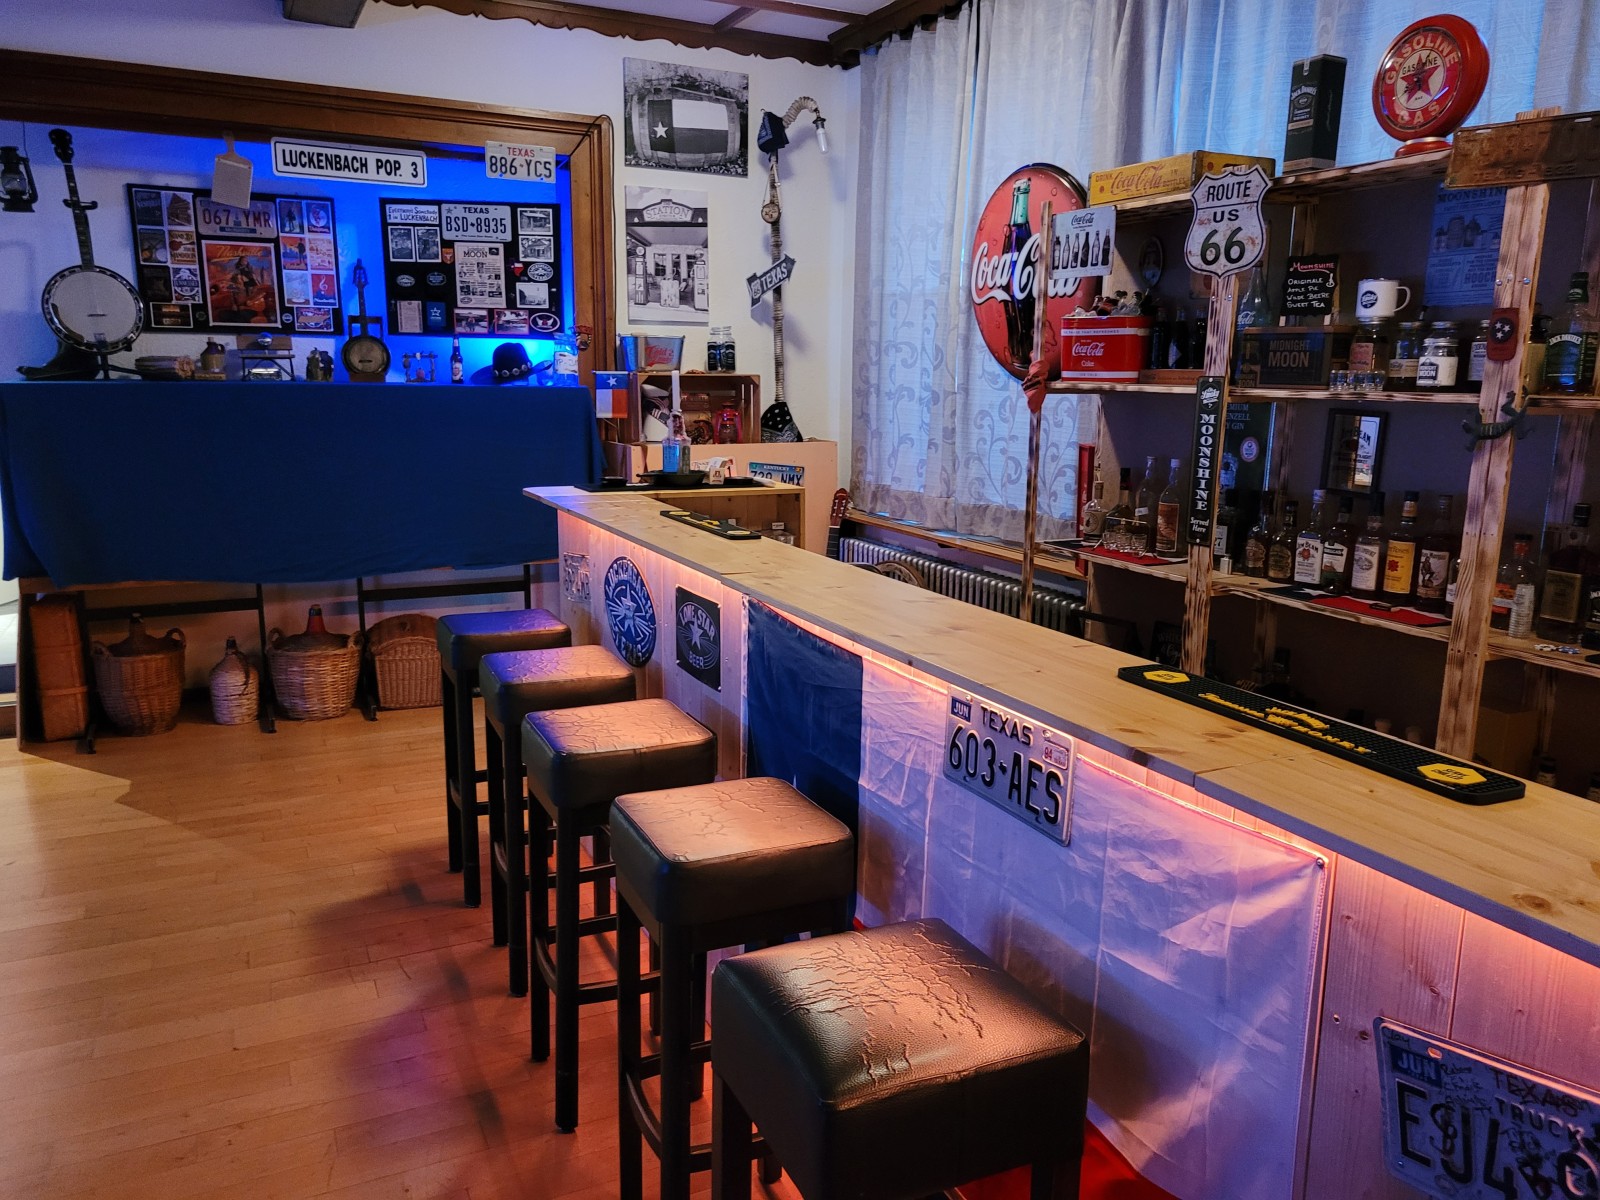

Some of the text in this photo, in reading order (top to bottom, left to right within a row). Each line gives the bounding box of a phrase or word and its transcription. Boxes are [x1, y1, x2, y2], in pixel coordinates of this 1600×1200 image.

[1385, 33, 1459, 84] GASOLINE
[507, 147, 535, 158] TEXAS
[282, 149, 418, 178] LUCKENBACH POP. 3
[489, 155, 552, 178] 886 YCS
[1207, 179, 1252, 202] ROUTE
[203, 208, 272, 228] 067 YMR
[400, 214, 438, 222] LUCKENBACH
[462, 206, 490, 214] TEXAS
[645, 206, 690, 219] STATION
[1071, 212, 1095, 226] Coca-Cola
[1213, 208, 1240, 223] US
[446, 216, 507, 234] BSD 8935
[464, 250, 488, 258] MOON
[1200, 226, 1246, 266] 66
[761, 262, 788, 290] TEXAS
[1072, 342, 1106, 356] Coca-Cola
[1269, 339, 1310, 351] MIDNIGHT
[1268, 351, 1310, 368] MOON
[763, 464, 790, 472] KENTUCKY
[1195, 413, 1217, 511] MOONSHINE
[780, 472, 803, 487] NMX
[1190, 516, 1210, 527] Served
[1192, 524, 1207, 534] Here
[680, 604, 715, 641] LONE STAR
[688, 650, 704, 669] BEER
[953, 702, 969, 718] JUN
[980, 704, 1034, 746] TEXAS
[950, 724, 1064, 825] 603 AES
[1397, 1051, 1436, 1080] JUN
[1489, 1067, 1578, 1116] TEXAS
[1494, 1095, 1584, 1143] TRUCK
